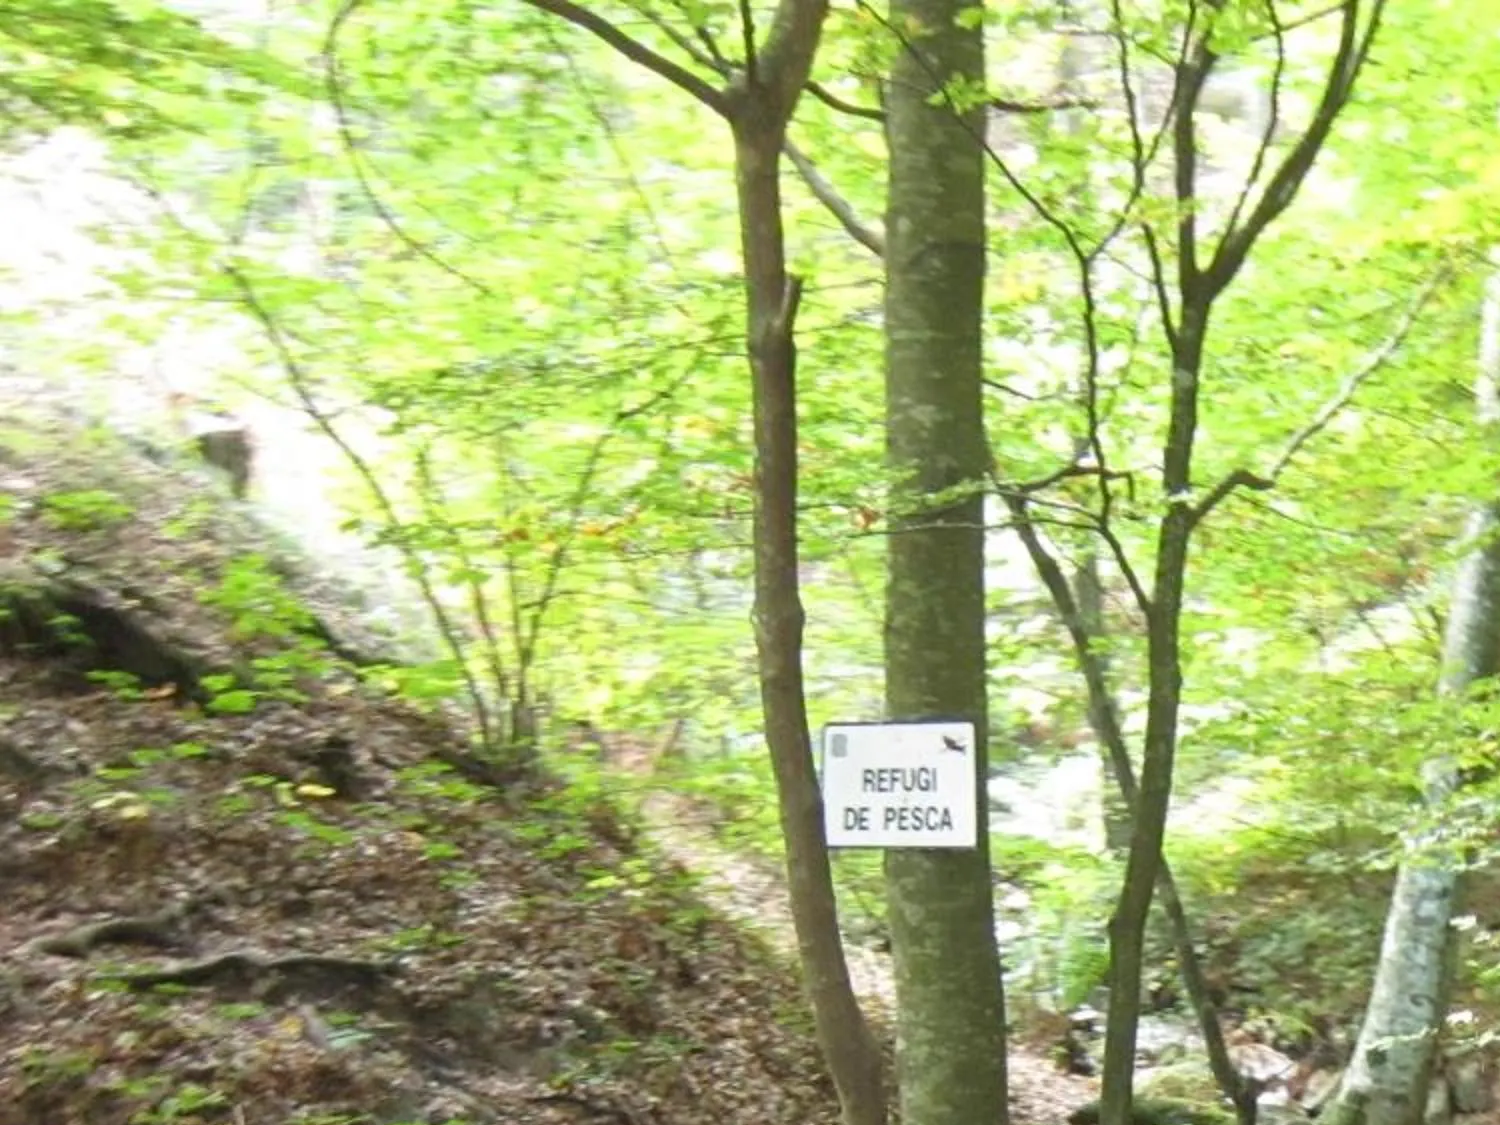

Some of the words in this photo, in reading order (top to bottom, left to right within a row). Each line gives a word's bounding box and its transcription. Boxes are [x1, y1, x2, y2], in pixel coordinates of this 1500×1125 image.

[862, 767, 938, 792] REFUGI
[843, 807, 870, 831] DE
[883, 806, 953, 831] PESCA
